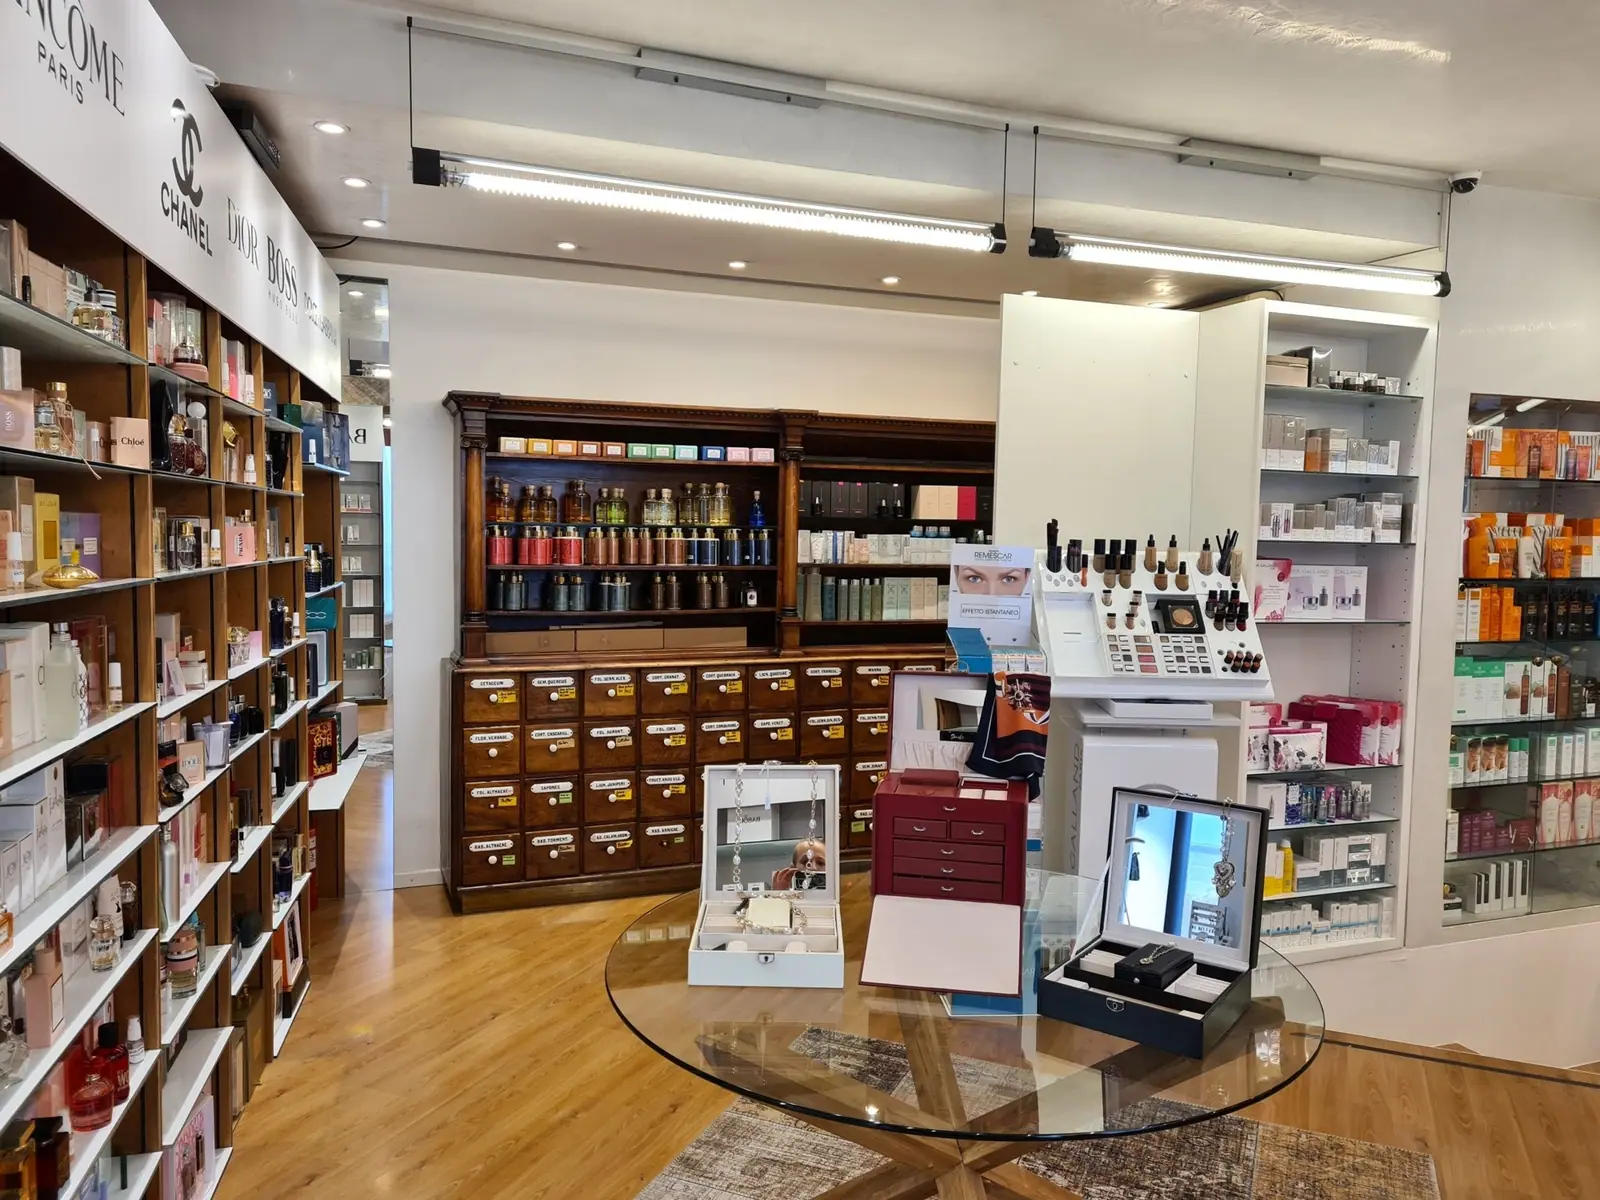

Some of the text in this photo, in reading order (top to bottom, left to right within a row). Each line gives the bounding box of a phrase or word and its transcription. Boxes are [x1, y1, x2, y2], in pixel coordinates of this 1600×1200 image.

[37, 39, 84, 104] PARIS
[160, 181, 213, 257] CHANEL
[266, 235, 298, 308] BOSS
[120, 436, 145, 446] Chloé
[974, 552, 1012, 560] REMESCAR
